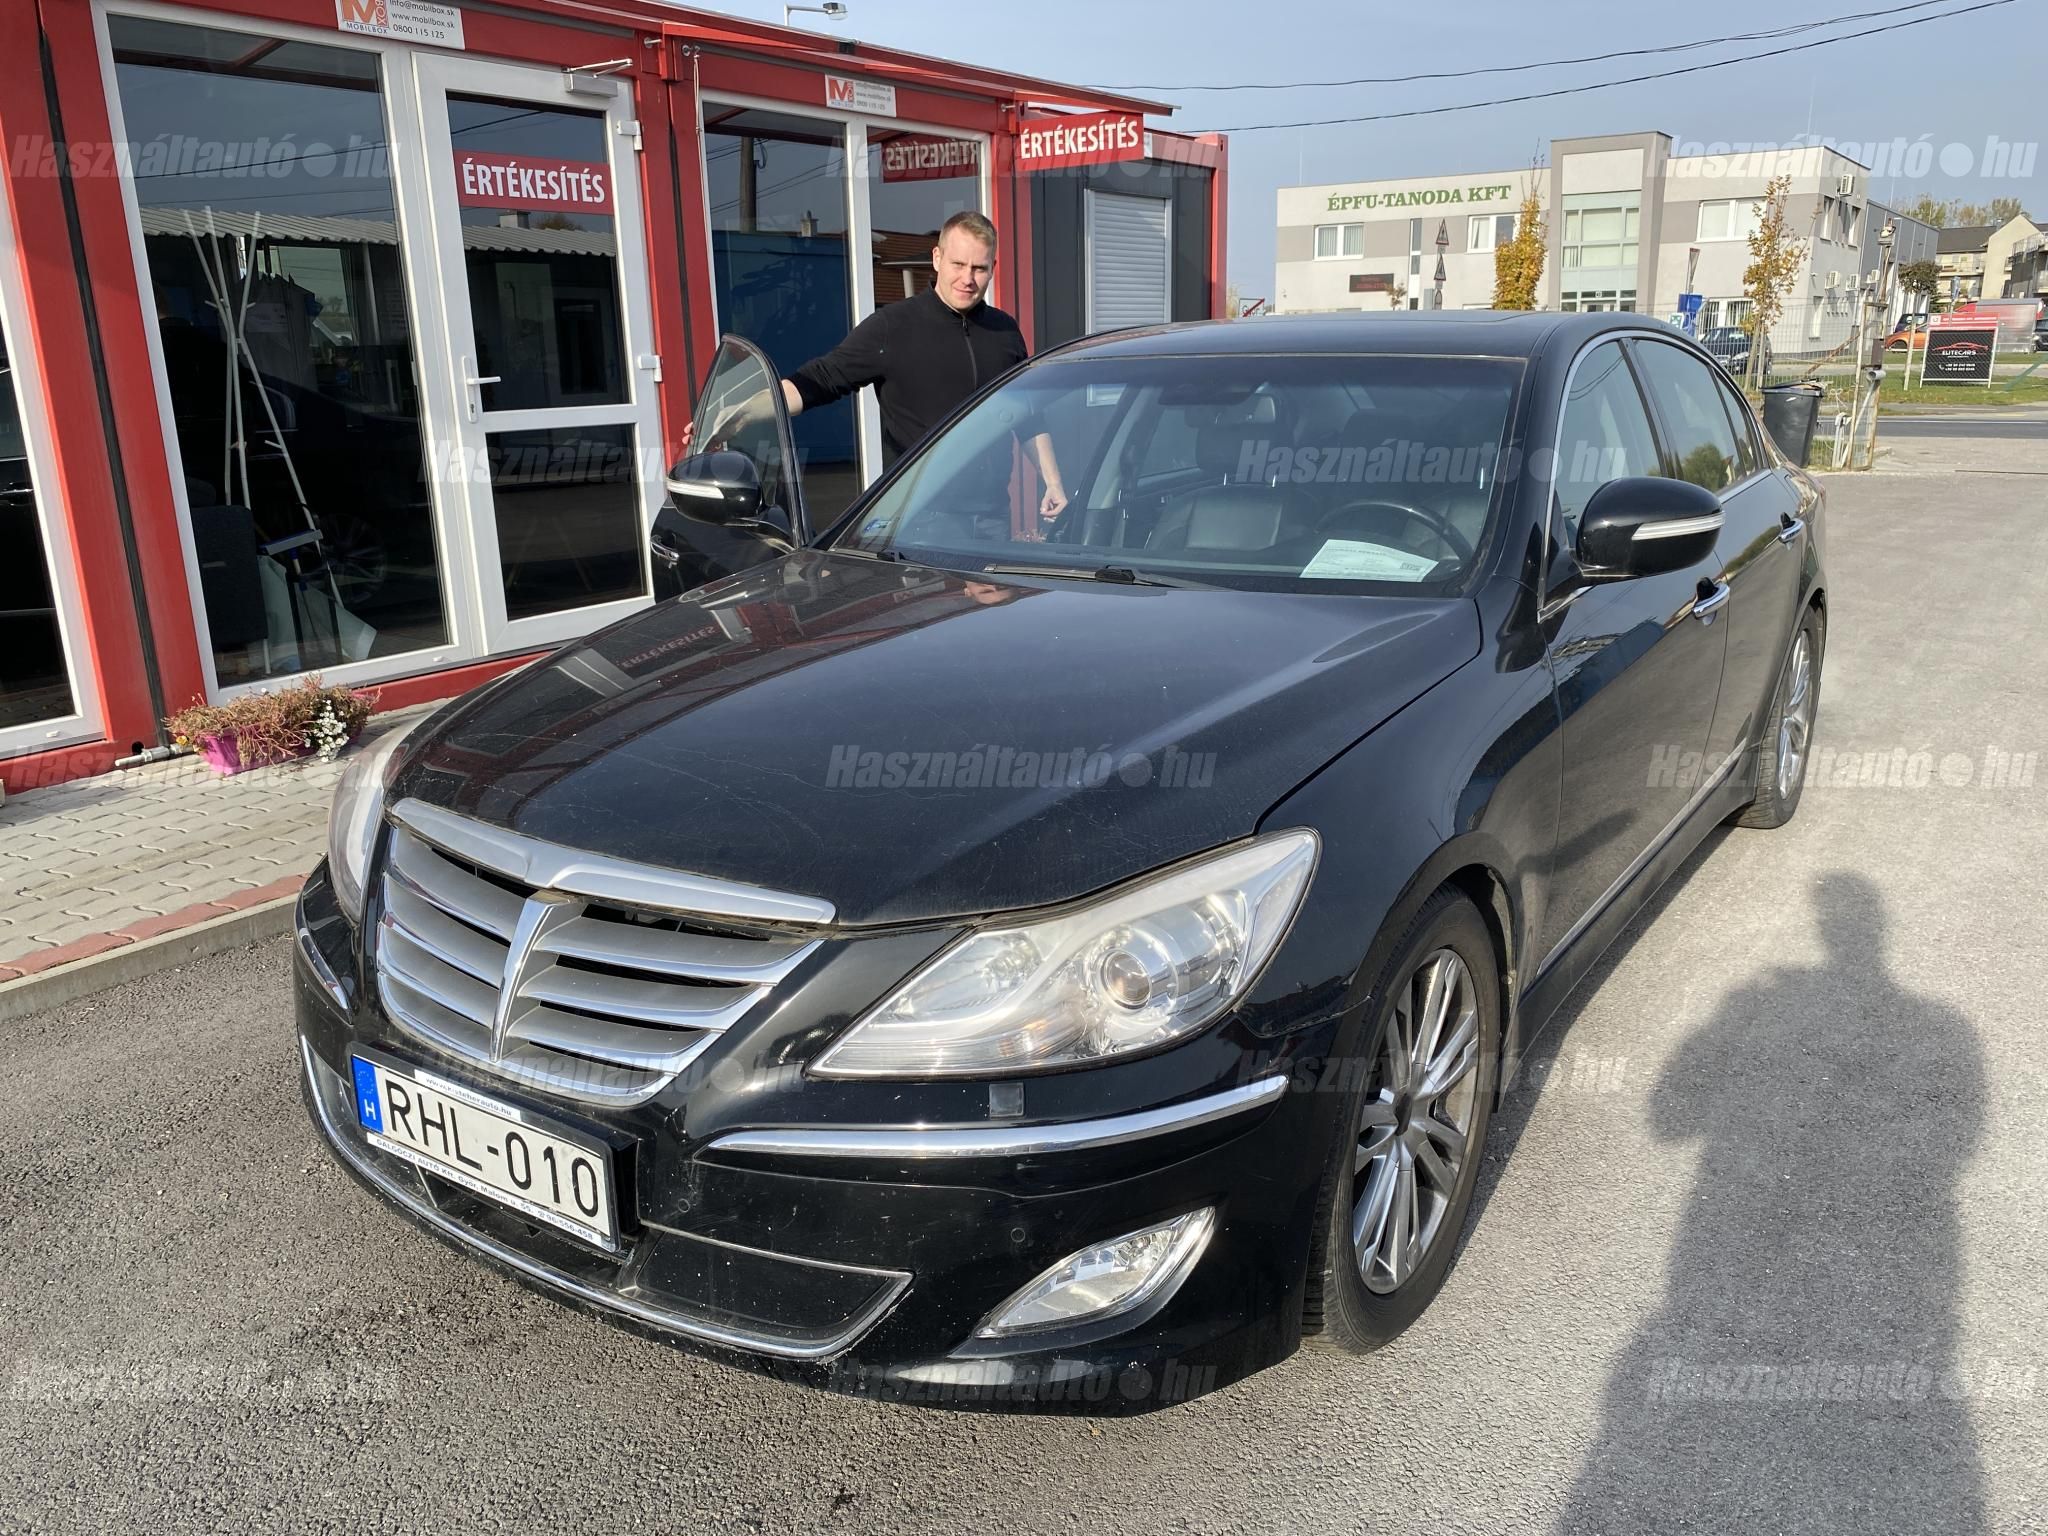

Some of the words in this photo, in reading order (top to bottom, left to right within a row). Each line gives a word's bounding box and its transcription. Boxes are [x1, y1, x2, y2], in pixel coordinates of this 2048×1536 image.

[346, 22, 388, 34] MOBILBOX
[392, 12, 455, 28] www.mobilbox.sk
[393, 24, 413, 34] 0800
[415, 27, 429, 37] 115
[431, 30, 445, 39] 125
[1020, 116, 1139, 160] ÉRTÉKESÍTÉS
[463, 156, 606, 204] ÉRTÉKESÍTÉS
[1327, 187, 1463, 212] ÉPFU-TANODA
[1467, 184, 1512, 202] KFT
[363, 1099, 378, 1123] H
[385, 1079, 600, 1218] RHL-010
[417, 1158, 440, 1172] AUTÓ
